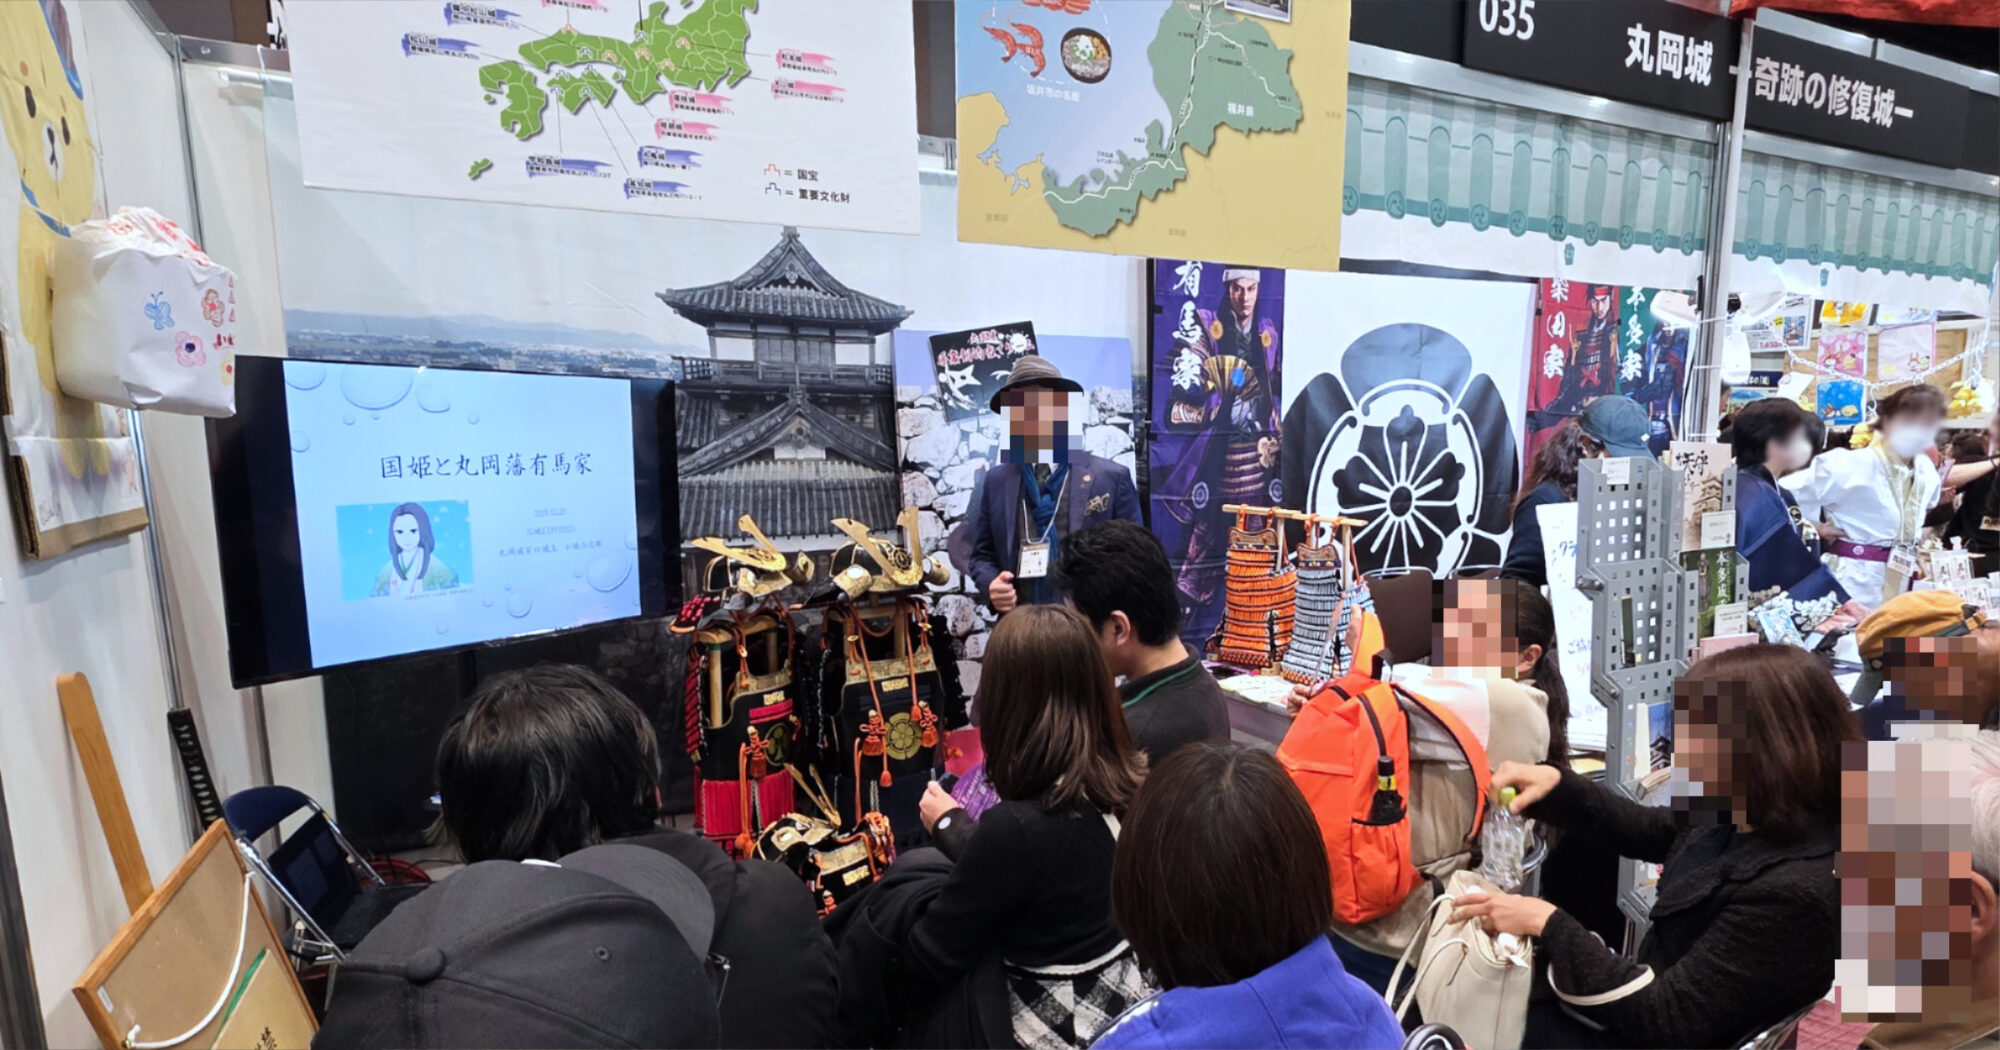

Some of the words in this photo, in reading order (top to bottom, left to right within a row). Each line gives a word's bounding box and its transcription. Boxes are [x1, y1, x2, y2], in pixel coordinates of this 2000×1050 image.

[1478, 0, 1536, 41] 035
[1625, 24, 1714, 86] 丸岡城
[1171, 260, 1204, 391] 有馬家
[380, 452, 593, 479] 国姫と丸岡藩有馬家
